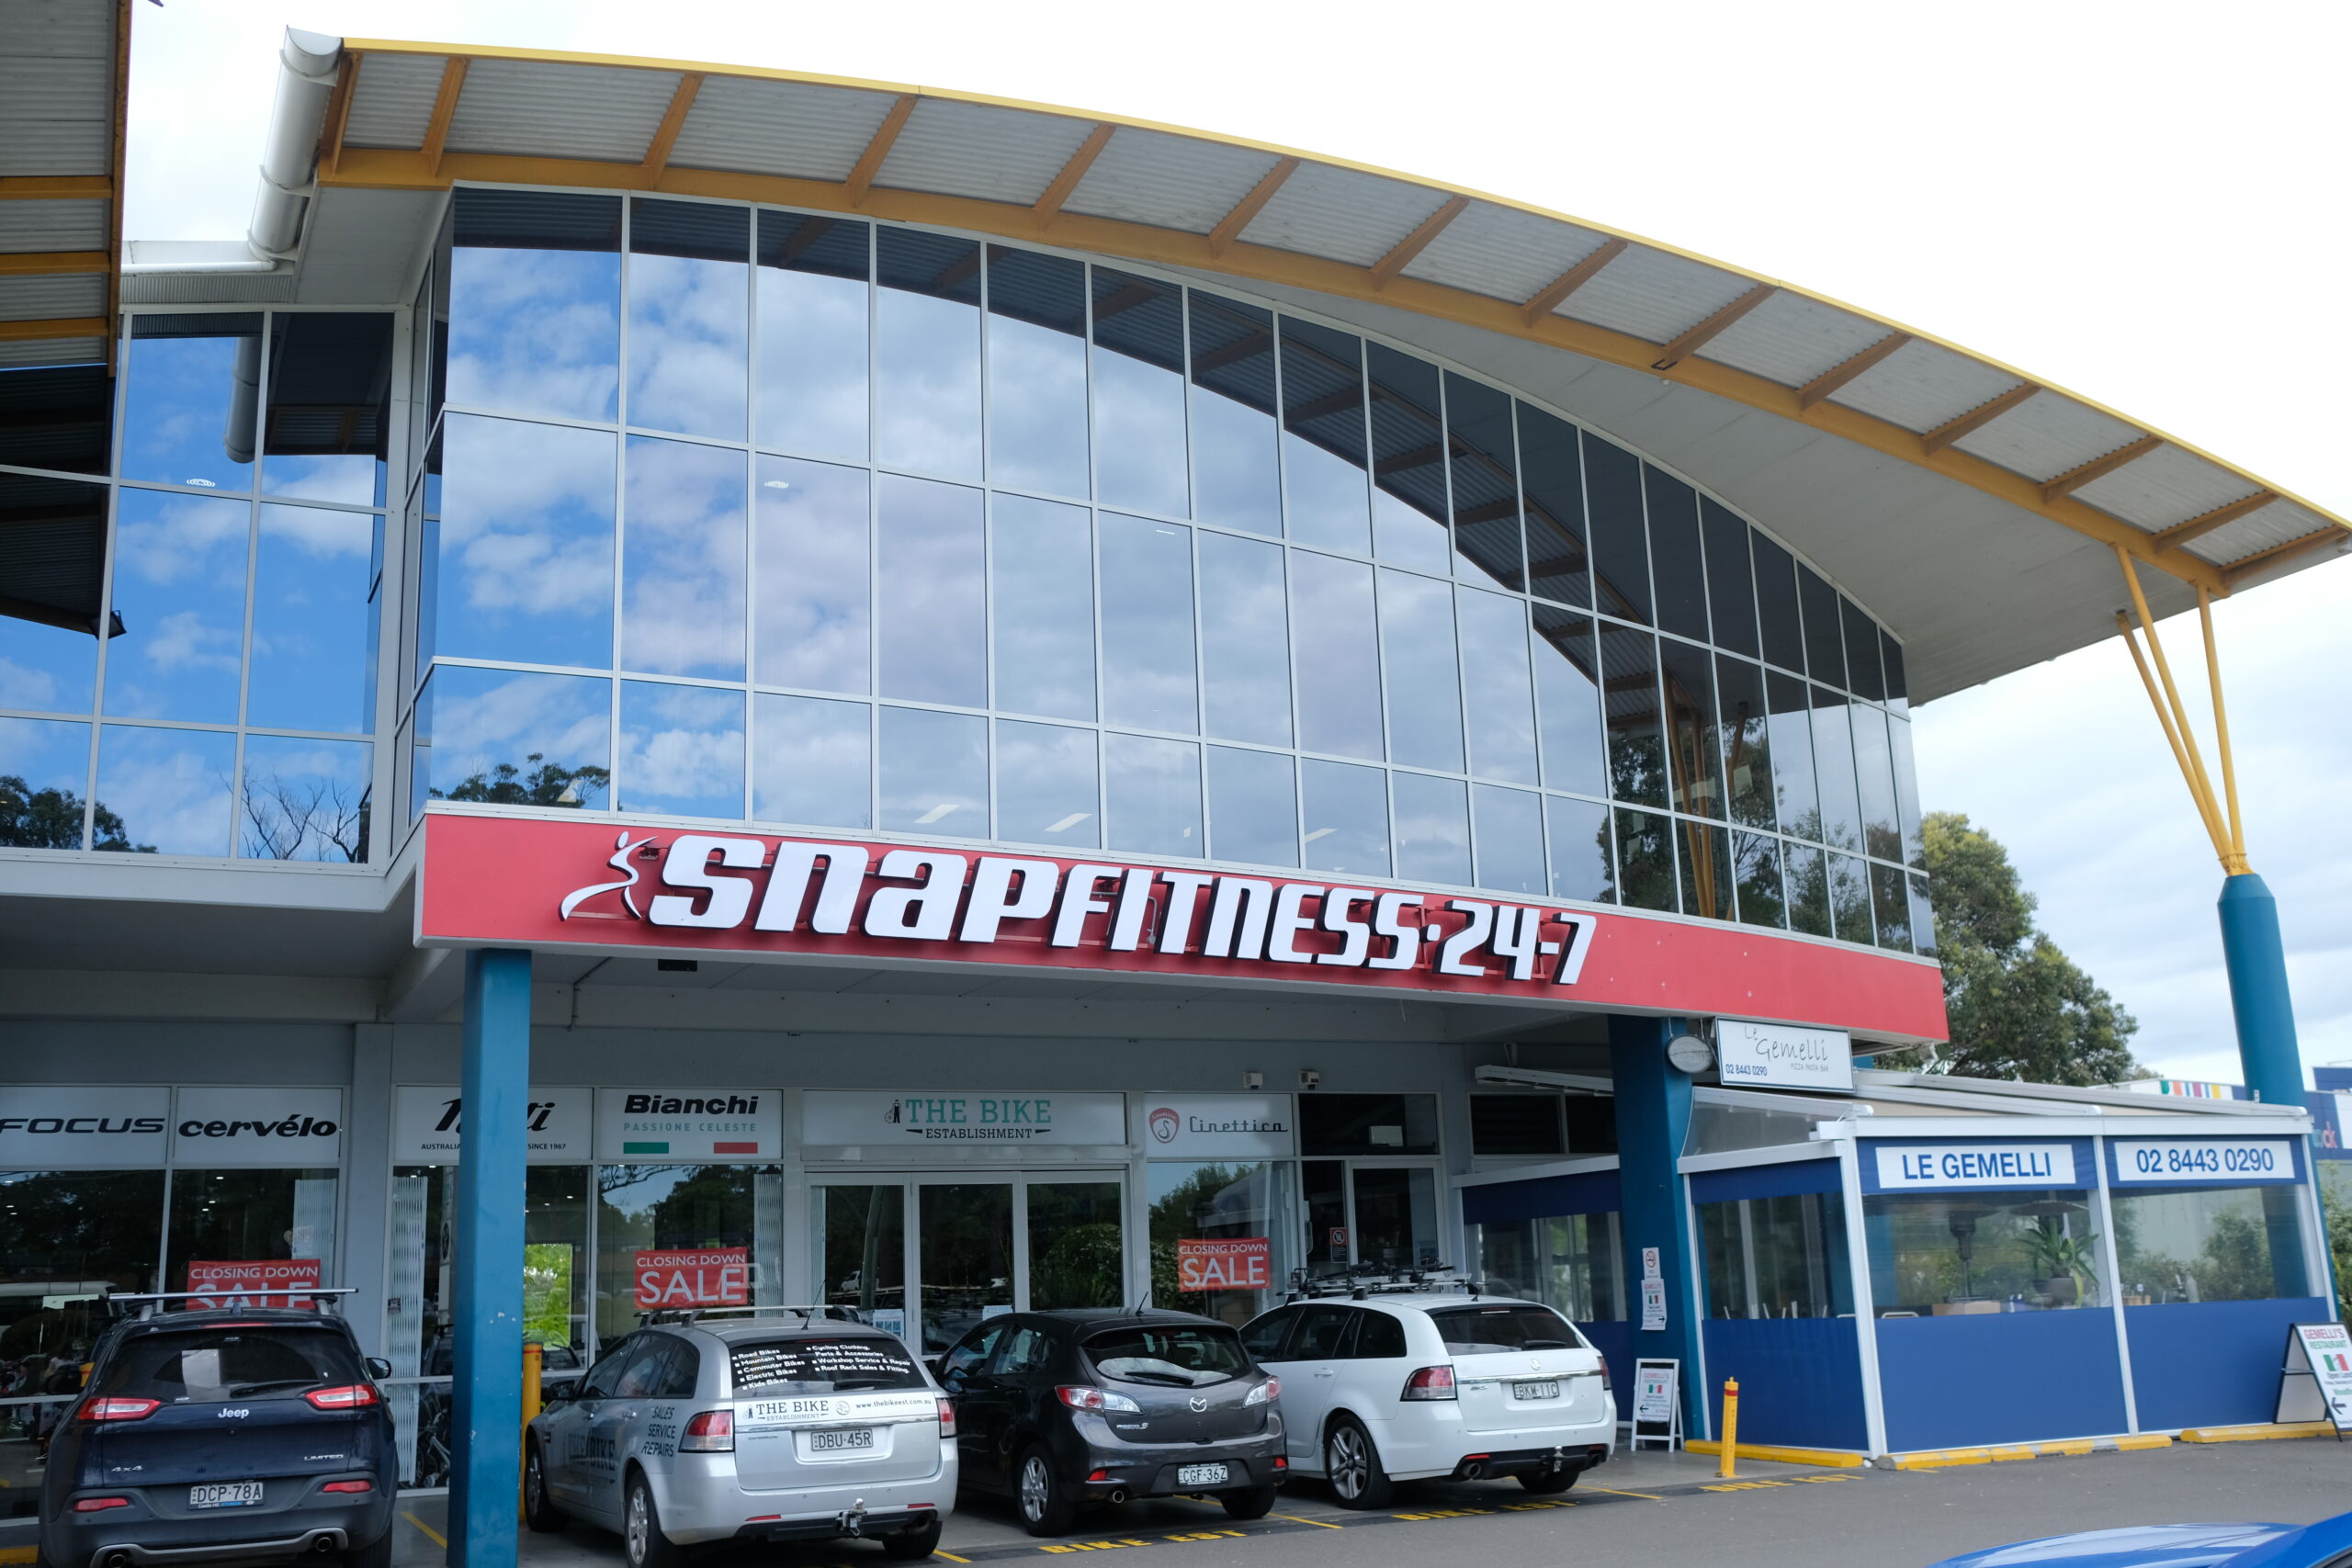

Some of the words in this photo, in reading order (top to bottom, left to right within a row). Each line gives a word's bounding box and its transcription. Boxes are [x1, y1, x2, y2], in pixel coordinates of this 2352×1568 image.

[1756, 1038, 1828, 1062] Gemelli
[1725, 1064, 1735, 1074] 02
[1736, 1065, 1751, 1076] 8443
[1752, 1066, 1768, 1077] 0290
[624, 1094, 759, 1114] Bianchi
[905, 1099, 967, 1123] THE
[979, 1100, 1051, 1123] BIKE
[0, 1118, 165, 1134] FOCUS
[178, 1114, 337, 1137] cervélo
[624, 1122, 691, 1132] PASSIONE
[699, 1122, 756, 1132] CELESTE
[1189, 1116, 1288, 1133] Cinettica
[926, 1128, 1032, 1139] ESTABLISHMENT
[1902, 1153, 1934, 1179] LE
[1941, 1152, 2052, 1179] GEMELLI
[2136, 1149, 2164, 1173] 02
[2168, 1148, 2220, 1172] 8443
[2224, 1148, 2274, 1172] 0290
[1179, 1245, 1227, 1255] CLOSING
[1231, 1243, 1268, 1253] DOWN
[636, 1255, 696, 1268] CLOSING
[700, 1254, 745, 1265] DOWN
[190, 1267, 261, 1280] CLOSING
[265, 1266, 318, 1278] DOWN
[1182, 1256, 1266, 1287] SALE
[640, 1269, 741, 1303] SALE
[741, 1357, 775, 1366] Mountain
[743, 1363, 782, 1372] Commuter
[745, 1371, 775, 1381] Electric
[756, 1403, 786, 1415] THE
[793, 1401, 829, 1413] BIKE
[855, 1399, 932, 1409] www.thebikeest.com.au
[218, 1407, 249, 1419] Jeep
[652, 1406, 675, 1420] SALES
[766, 1413, 820, 1421] ESTABLISHMENT
[648, 1424, 676, 1438] SERVICE
[641, 1441, 674, 1457] REPAIRS
[1038, 1539, 1153, 1553] BIKE
[1161, 1529, 1248, 1542] EST
